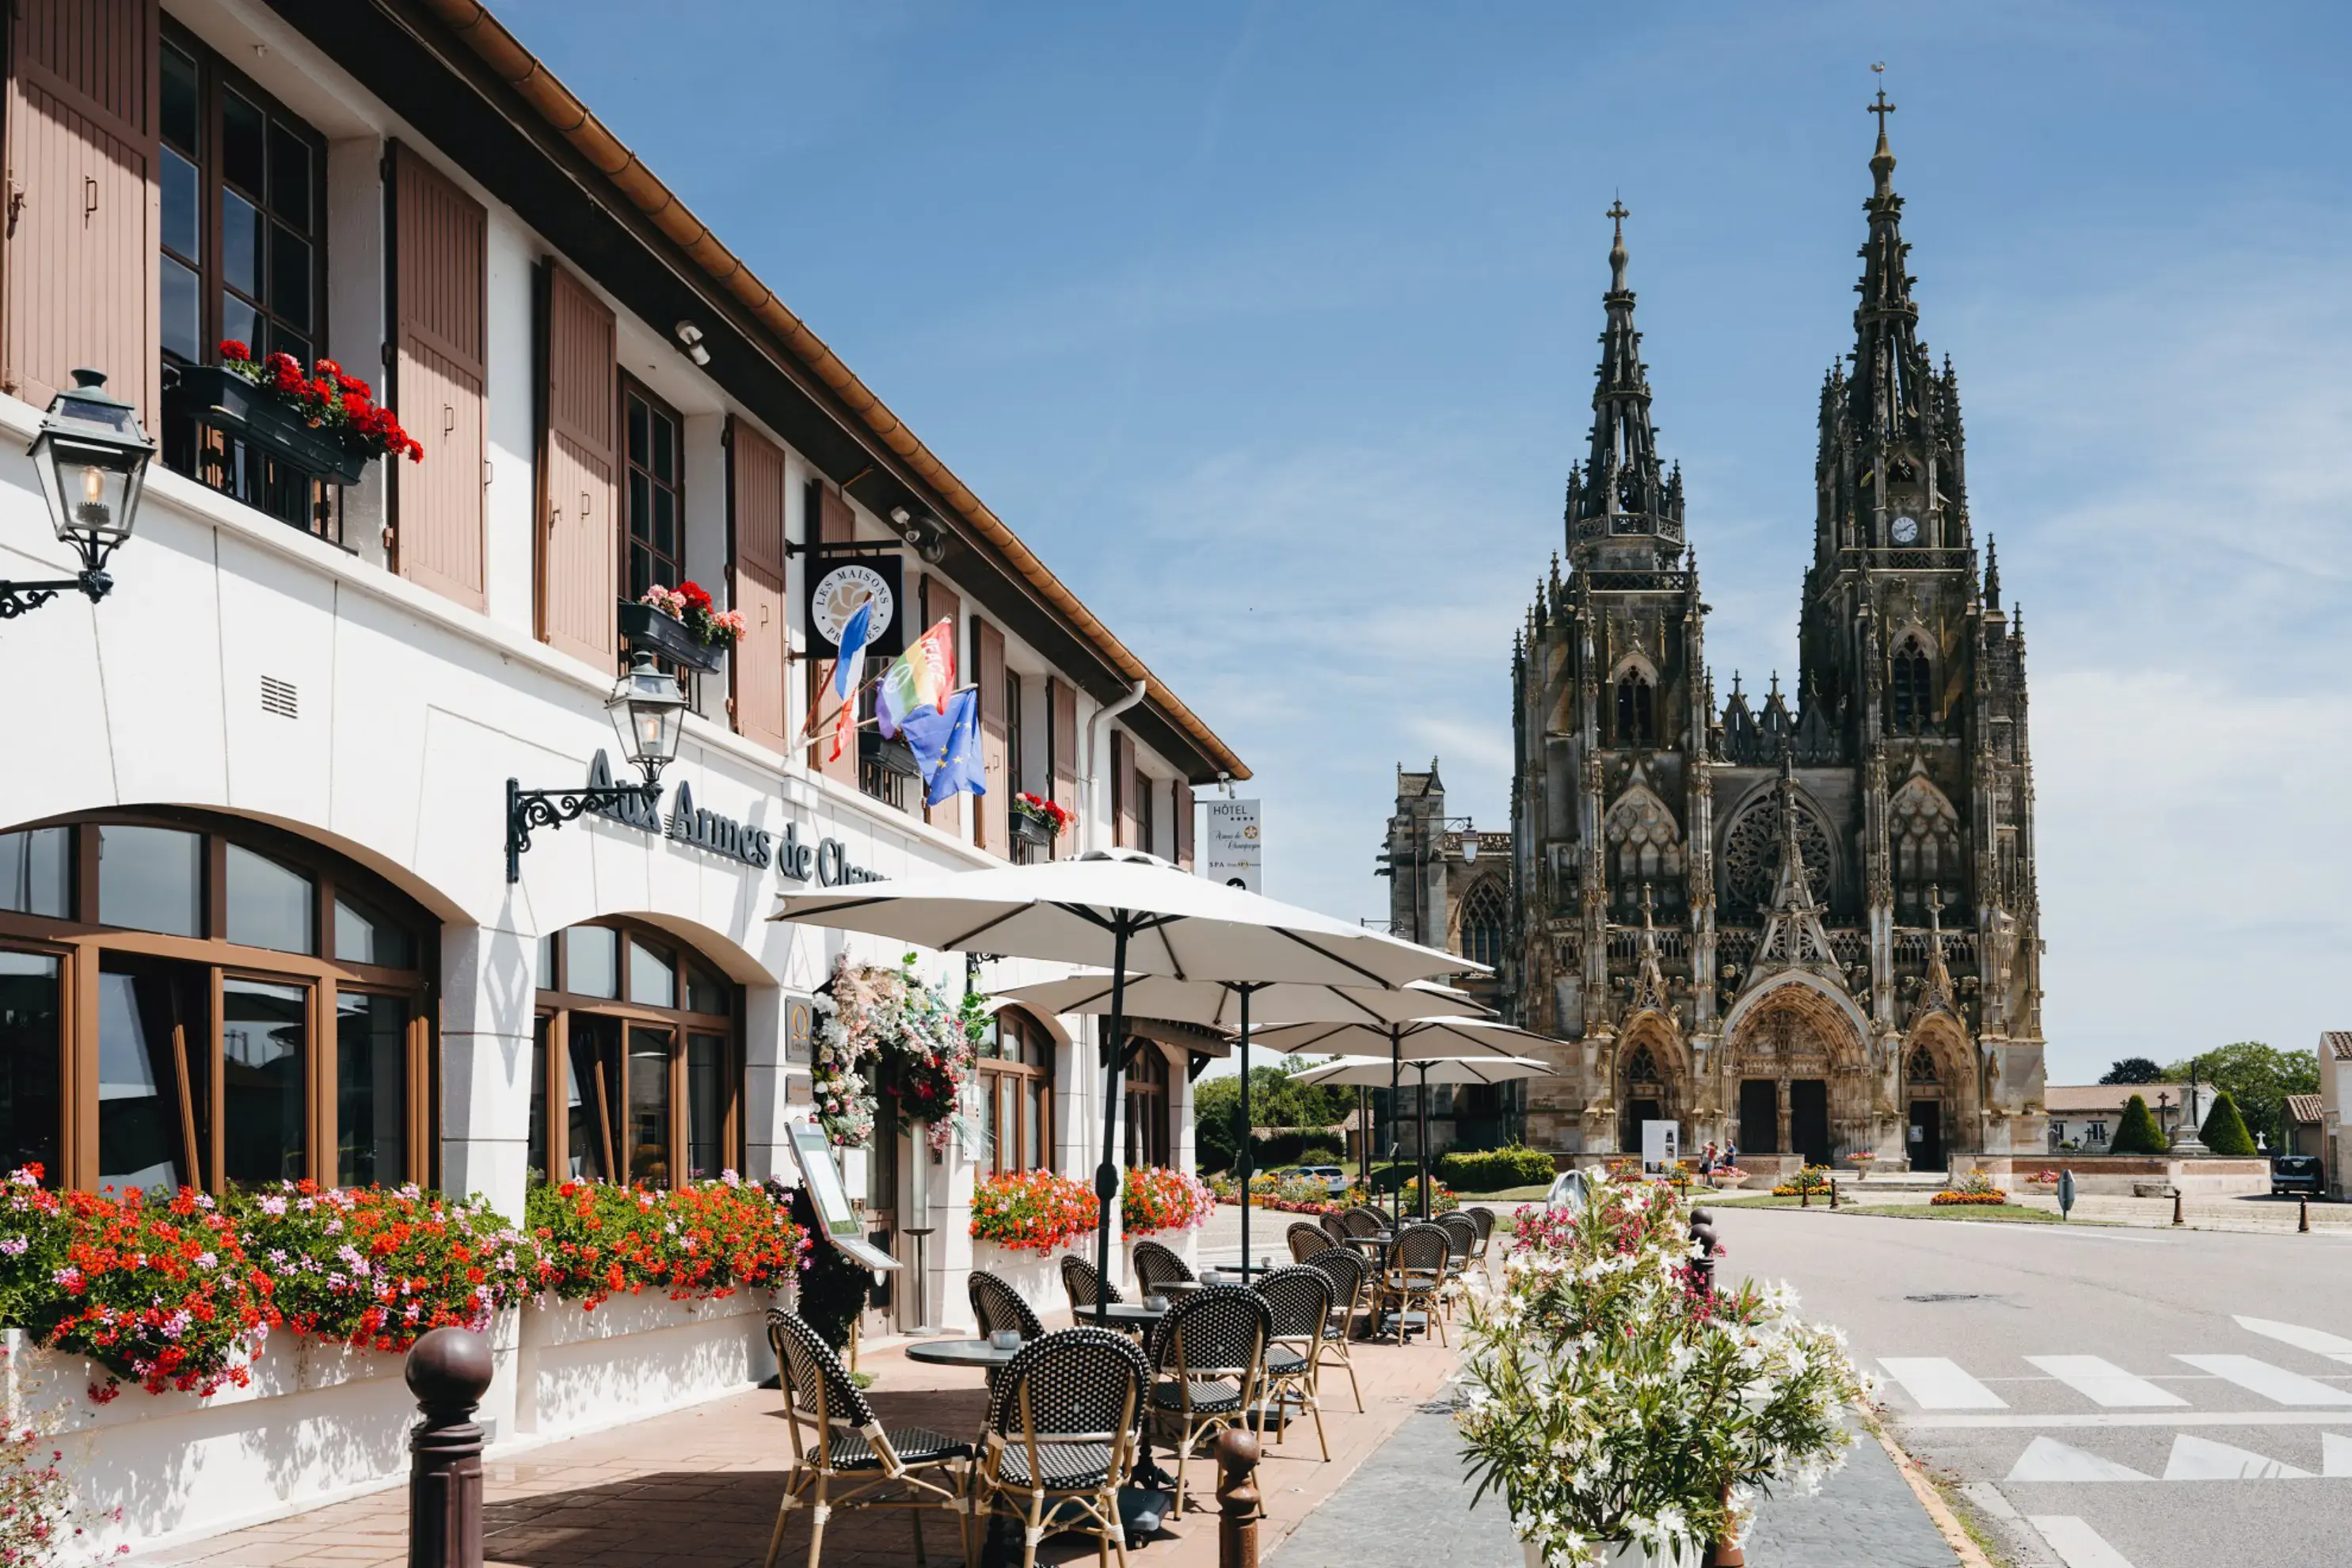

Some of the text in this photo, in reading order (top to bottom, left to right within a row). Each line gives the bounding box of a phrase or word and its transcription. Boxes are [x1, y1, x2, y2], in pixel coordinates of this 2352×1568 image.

[816, 569, 889, 606] LES MAISONS
[587, 748, 663, 835] Aux
[671, 779, 772, 870] Armes
[778, 822, 813, 882] de
[1213, 804, 1248, 815] HÔTEL
